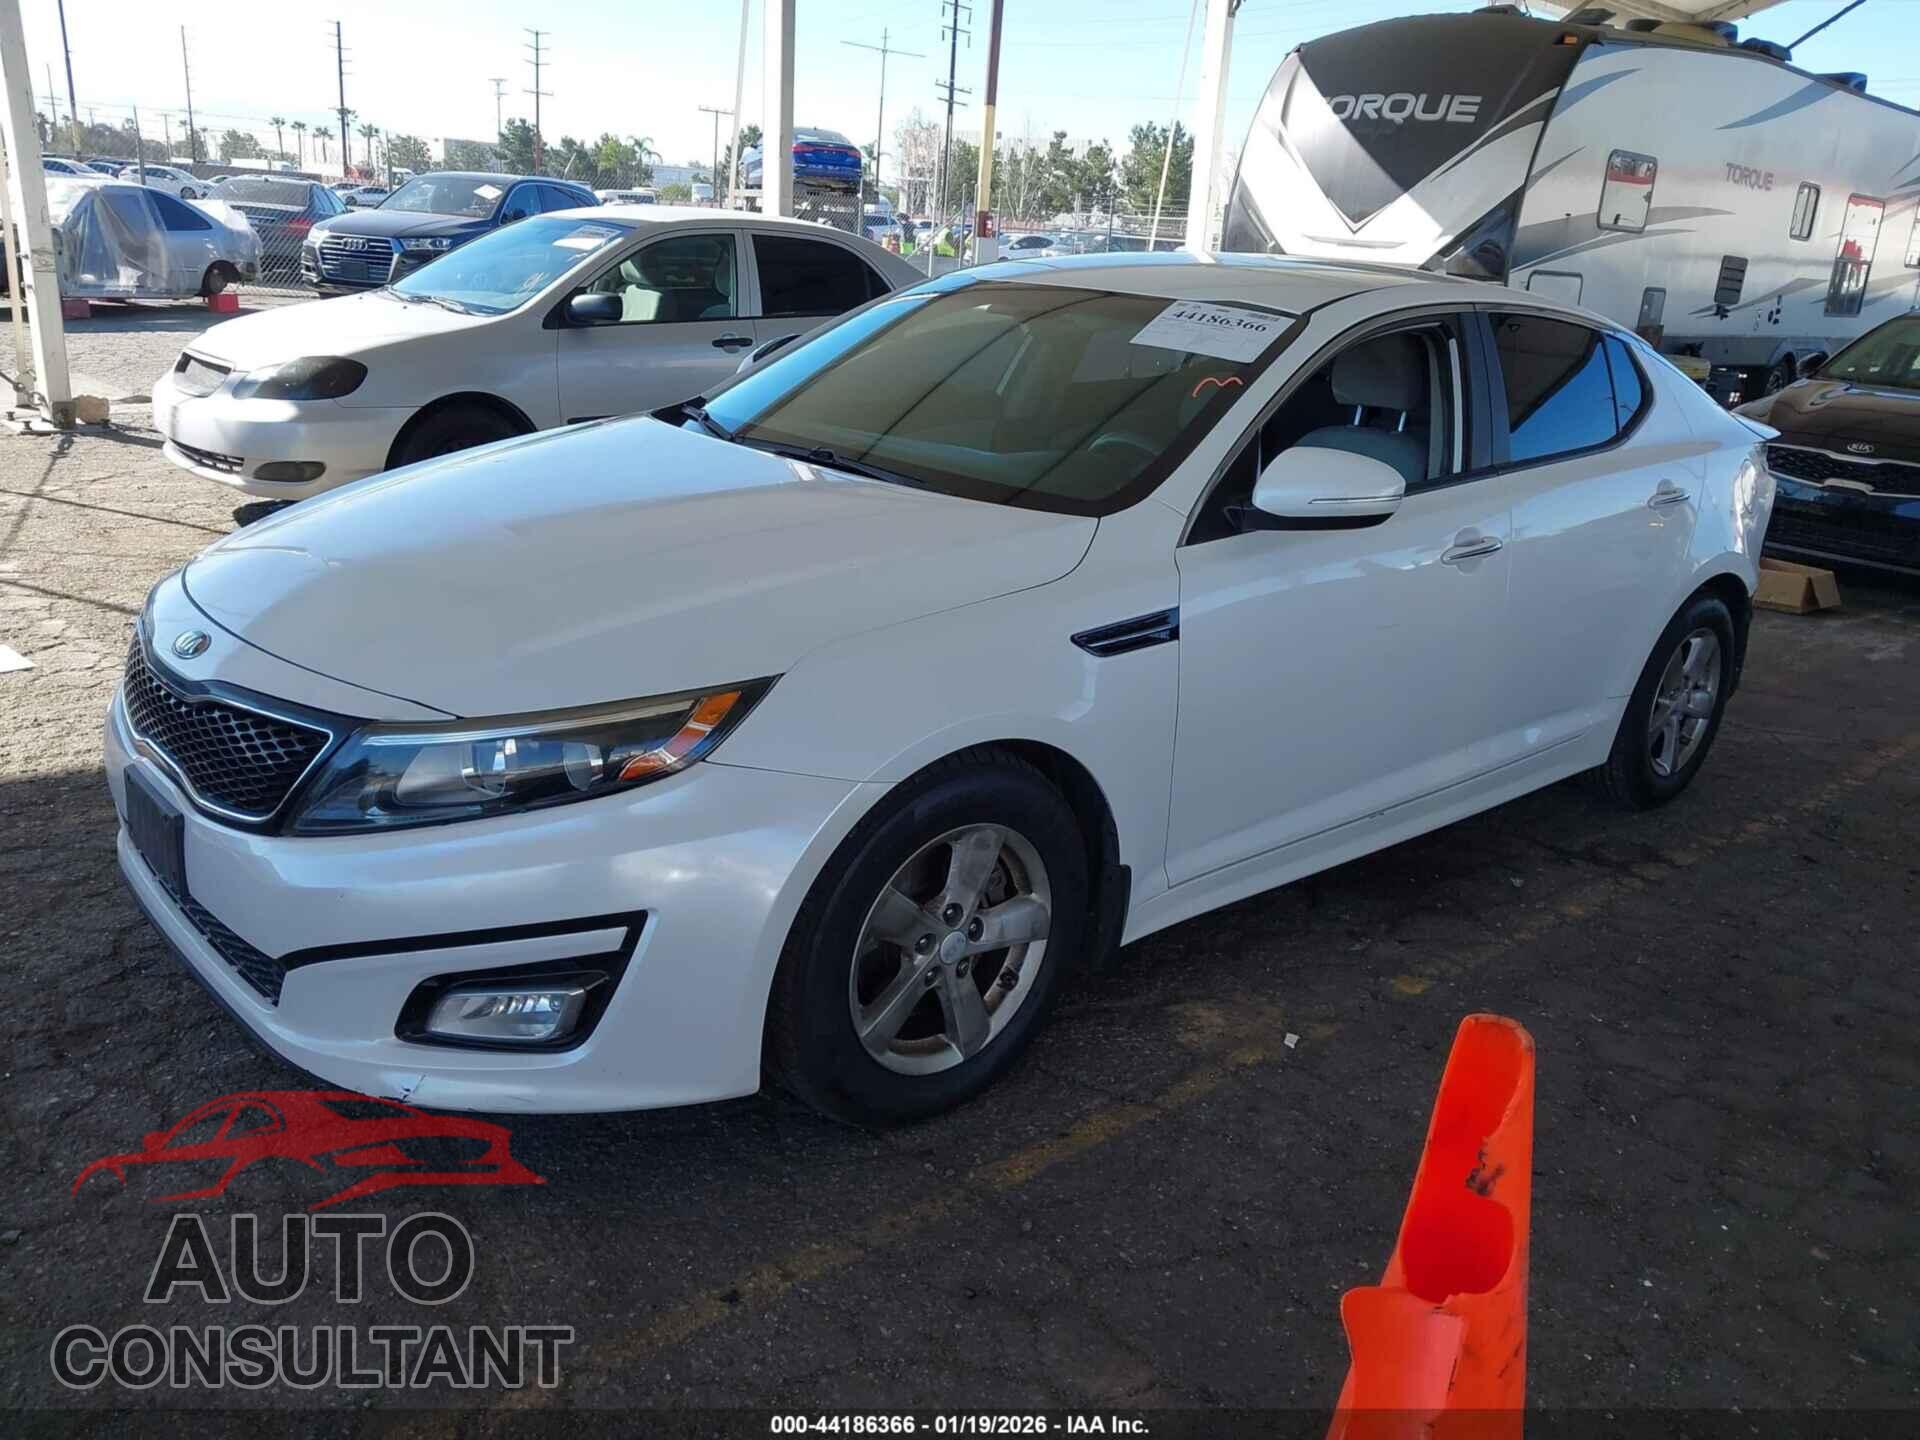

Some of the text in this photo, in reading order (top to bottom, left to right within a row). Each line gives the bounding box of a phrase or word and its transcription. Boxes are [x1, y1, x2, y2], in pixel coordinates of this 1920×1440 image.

[1324, 93, 1483, 126] ORQUE
[1726, 162, 1775, 191] TORQUE
[1173, 310, 1268, 333] 44186366
